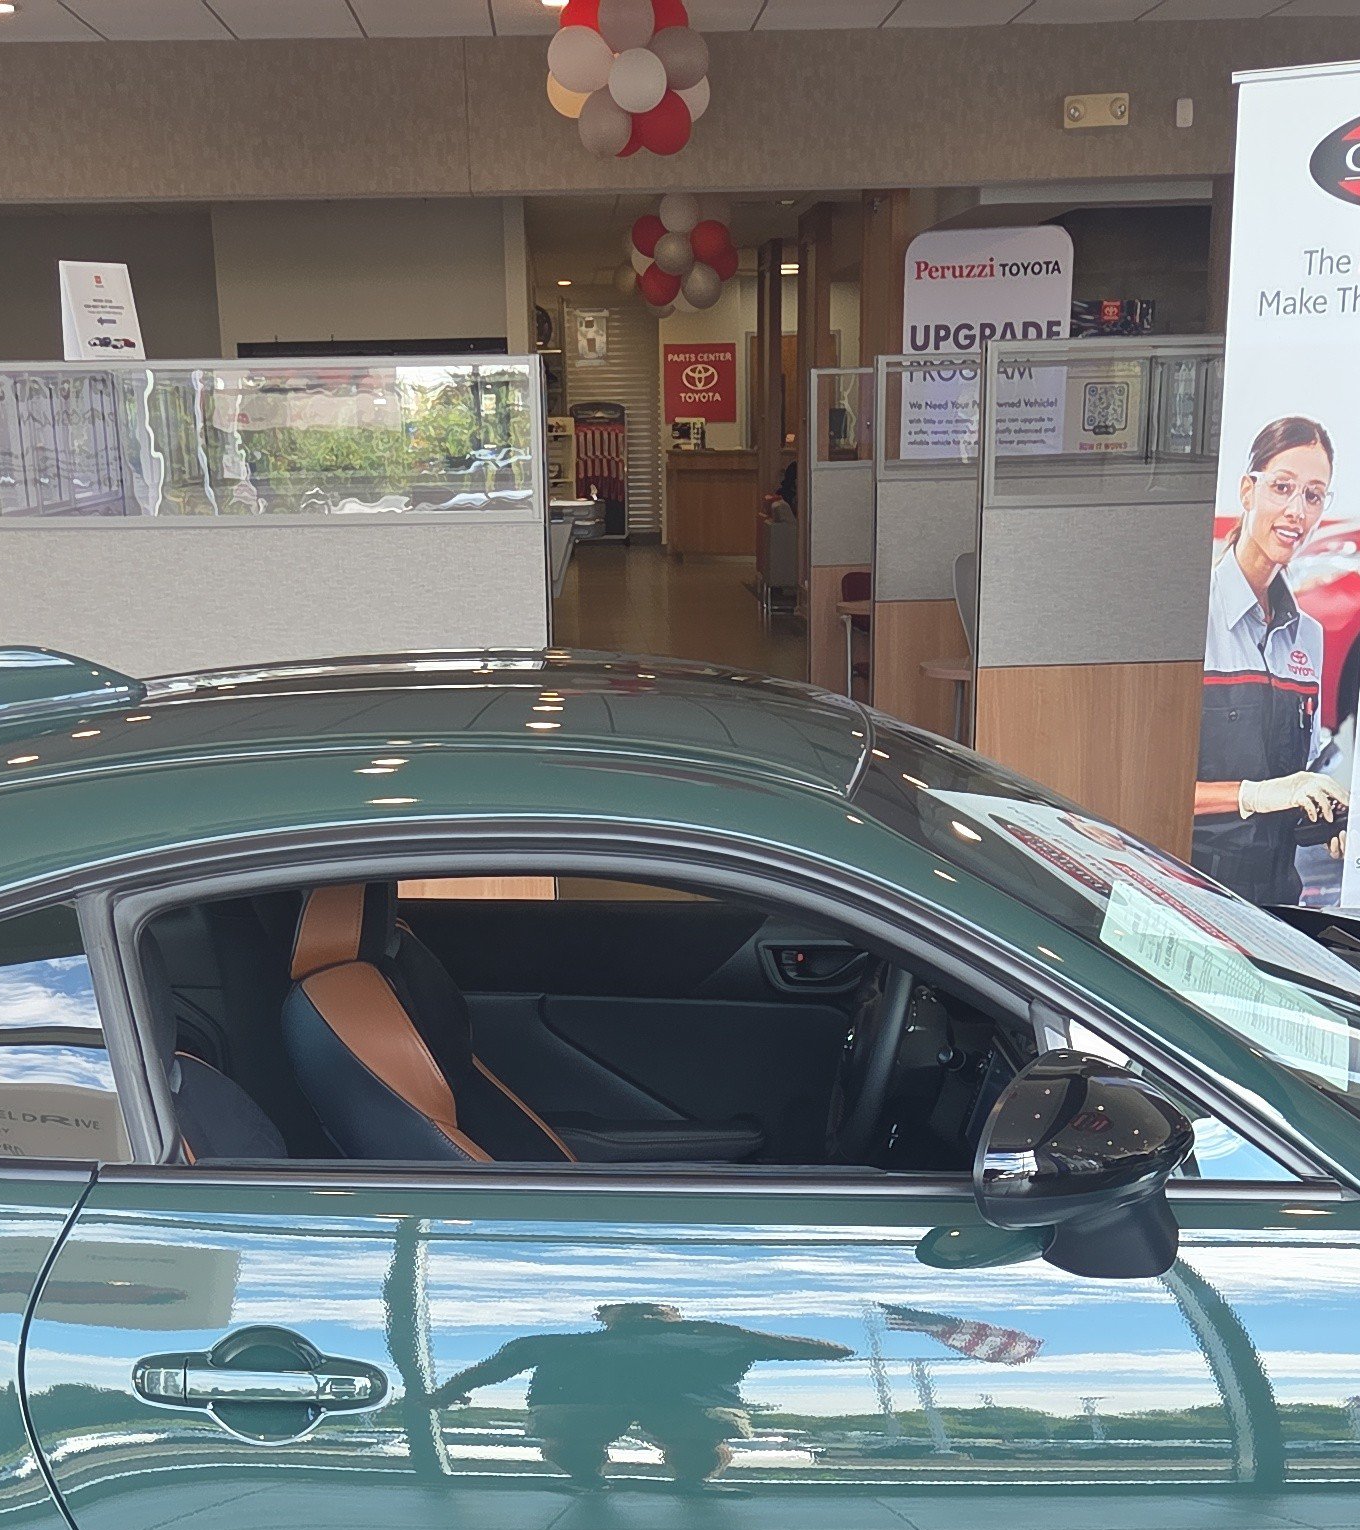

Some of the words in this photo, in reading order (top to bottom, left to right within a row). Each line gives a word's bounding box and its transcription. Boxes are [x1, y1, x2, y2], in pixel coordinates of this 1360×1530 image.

[914, 257, 996, 280] Peruzzi
[999, 259, 1062, 278] TOYOTA
[1304, 248, 1352, 276] The
[1259, 288, 1328, 316] Make
[909, 320, 1063, 351] UPGRADE
[667, 353, 696, 362] PARTS
[697, 352, 732, 362] CENTER
[908, 359, 1034, 382] PROGAM
[679, 392, 722, 402] TOYOTA
